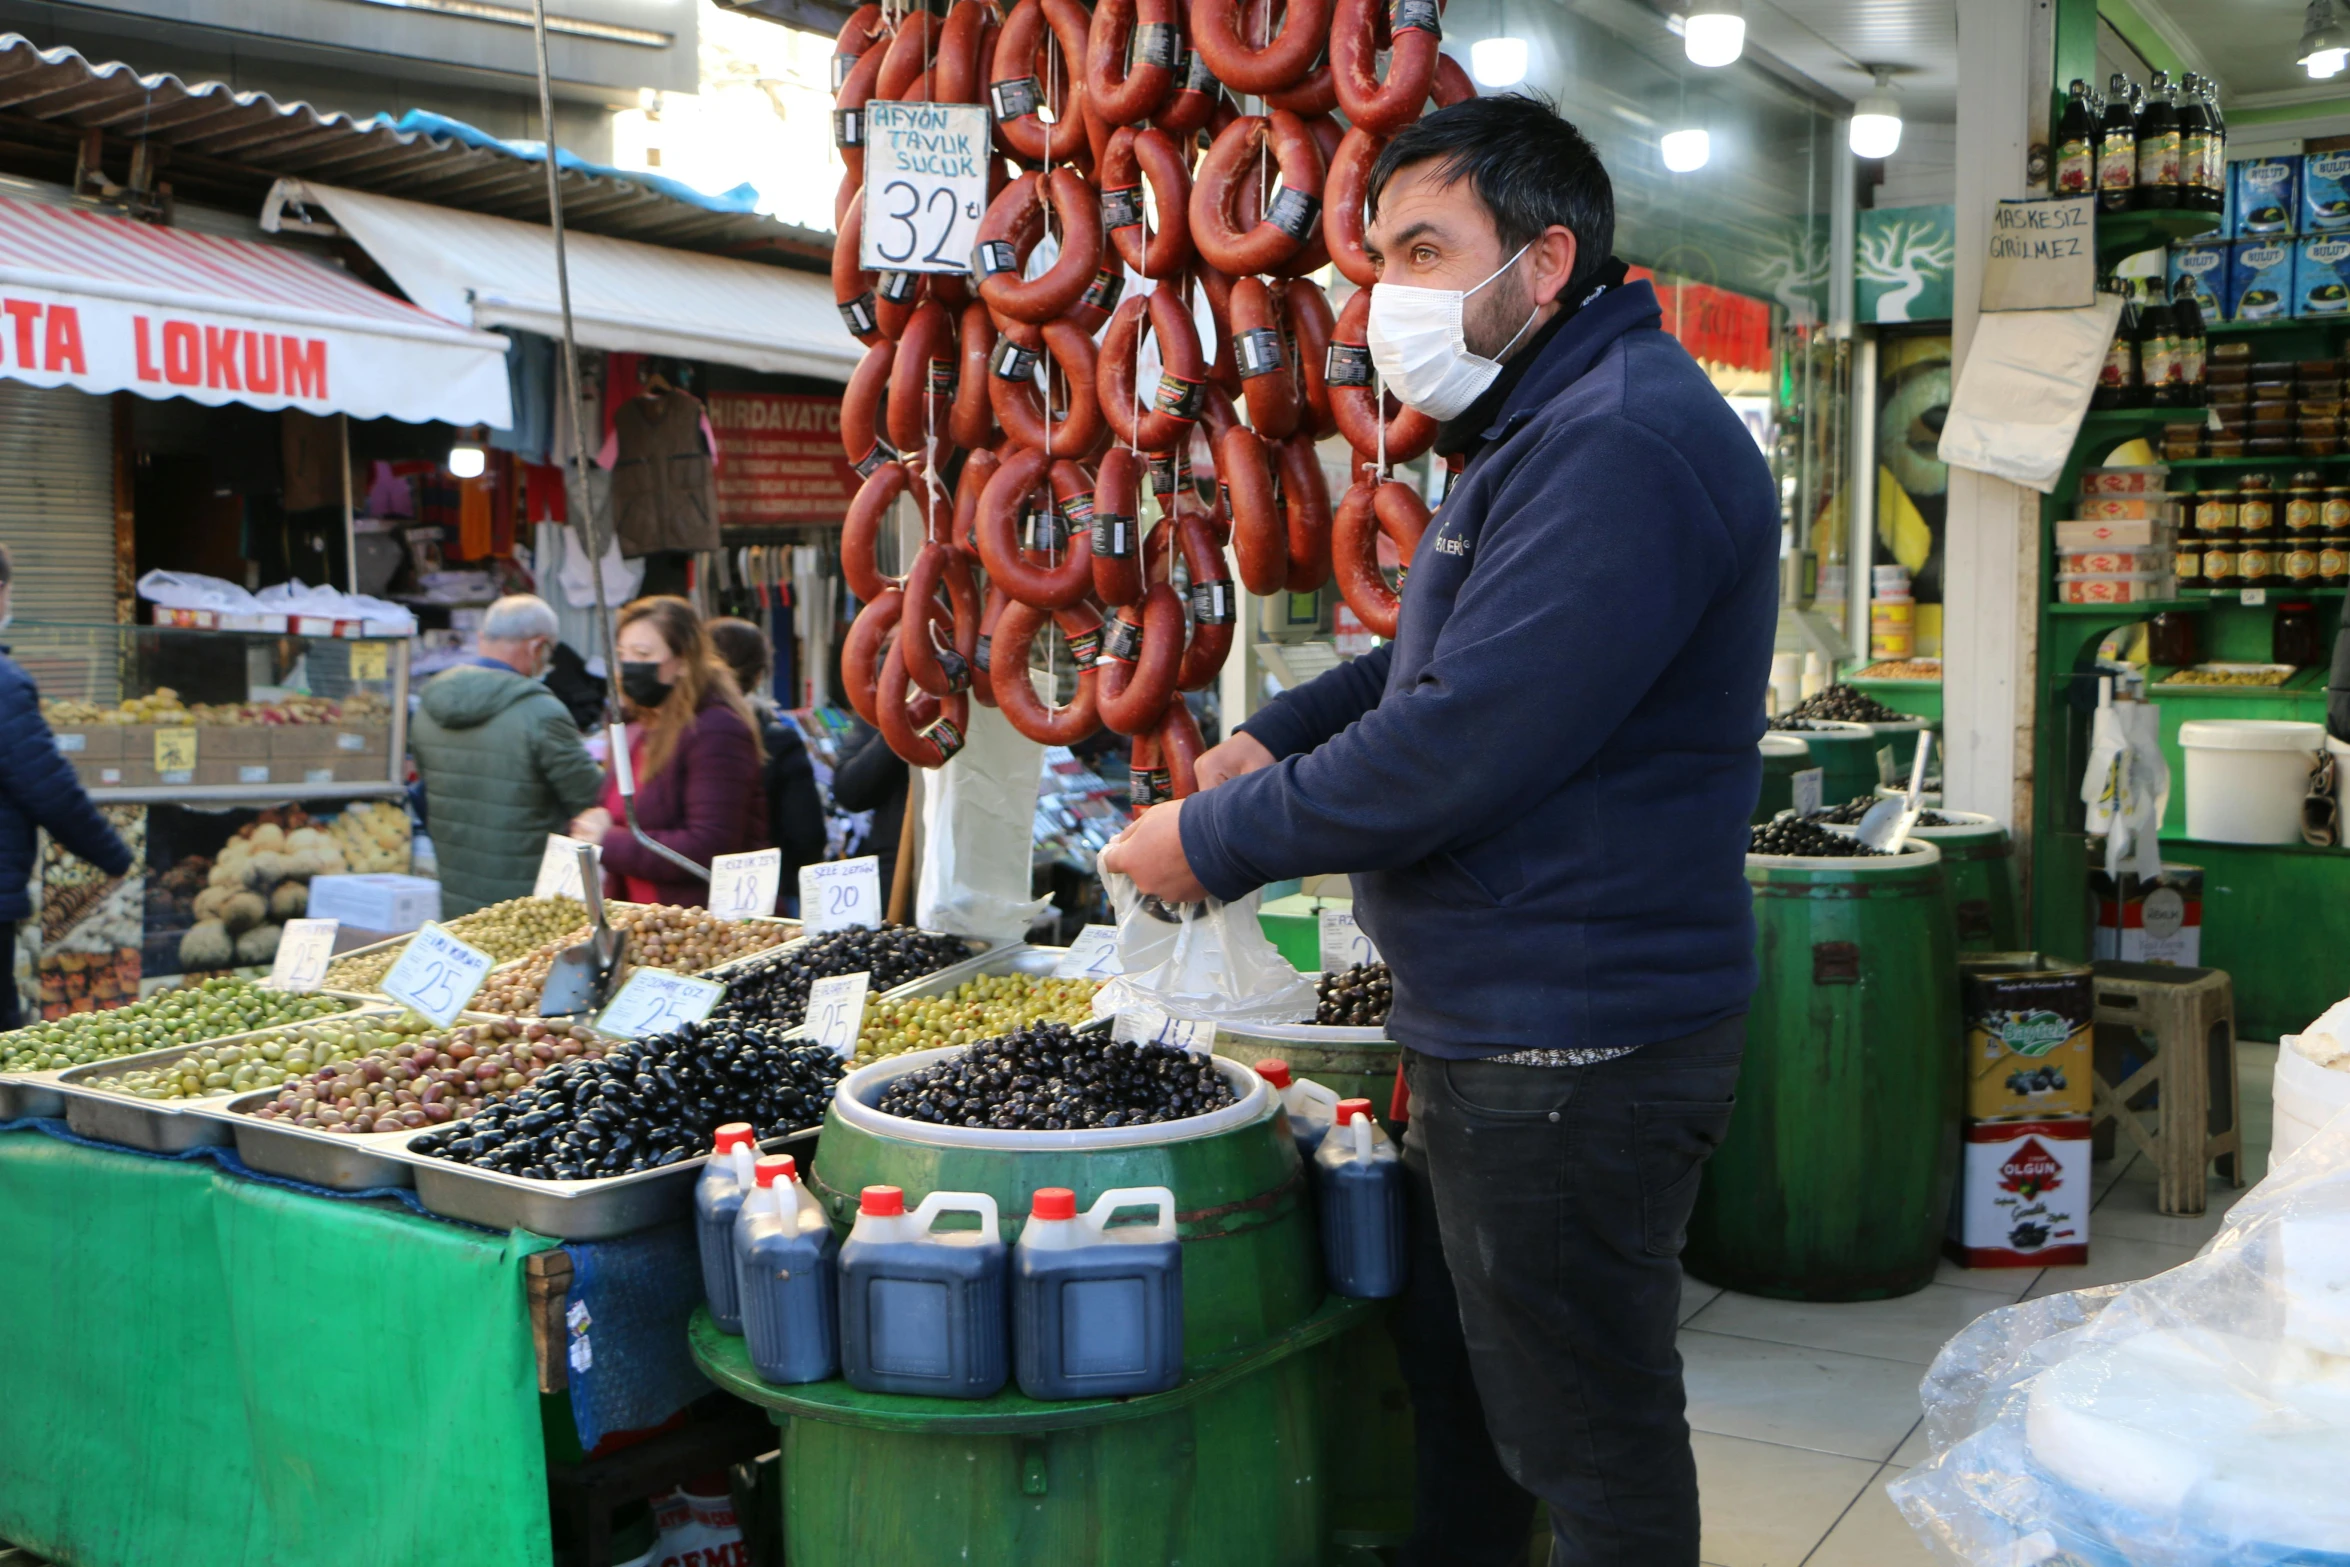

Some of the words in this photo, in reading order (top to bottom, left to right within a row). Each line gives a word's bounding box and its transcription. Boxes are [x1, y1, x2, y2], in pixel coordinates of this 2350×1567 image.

[874, 104, 949, 131] AFYON
[887, 130, 972, 156] TAVUK
[896, 151, 978, 178] SUCUK
[2251, 166, 2285, 180] BULUT
[877, 180, 967, 269] 32
[1989, 233, 2083, 259] GİRİLMEZ
[2247, 249, 2280, 262] BULUT
[2313, 244, 2347, 257] BULUT
[2183, 254, 2215, 267] BULUT
[0, 297, 88, 375] TA
[133, 315, 329, 400] LOKUM
[730, 874, 759, 912] 18
[828, 884, 860, 916] 20
[289, 942, 321, 982] 25
[409, 960, 463, 1014] 25
[634, 996, 687, 1033] 25
[820, 1003, 849, 1051] 25
[2004, 1162, 2056, 1175] OLGUN
